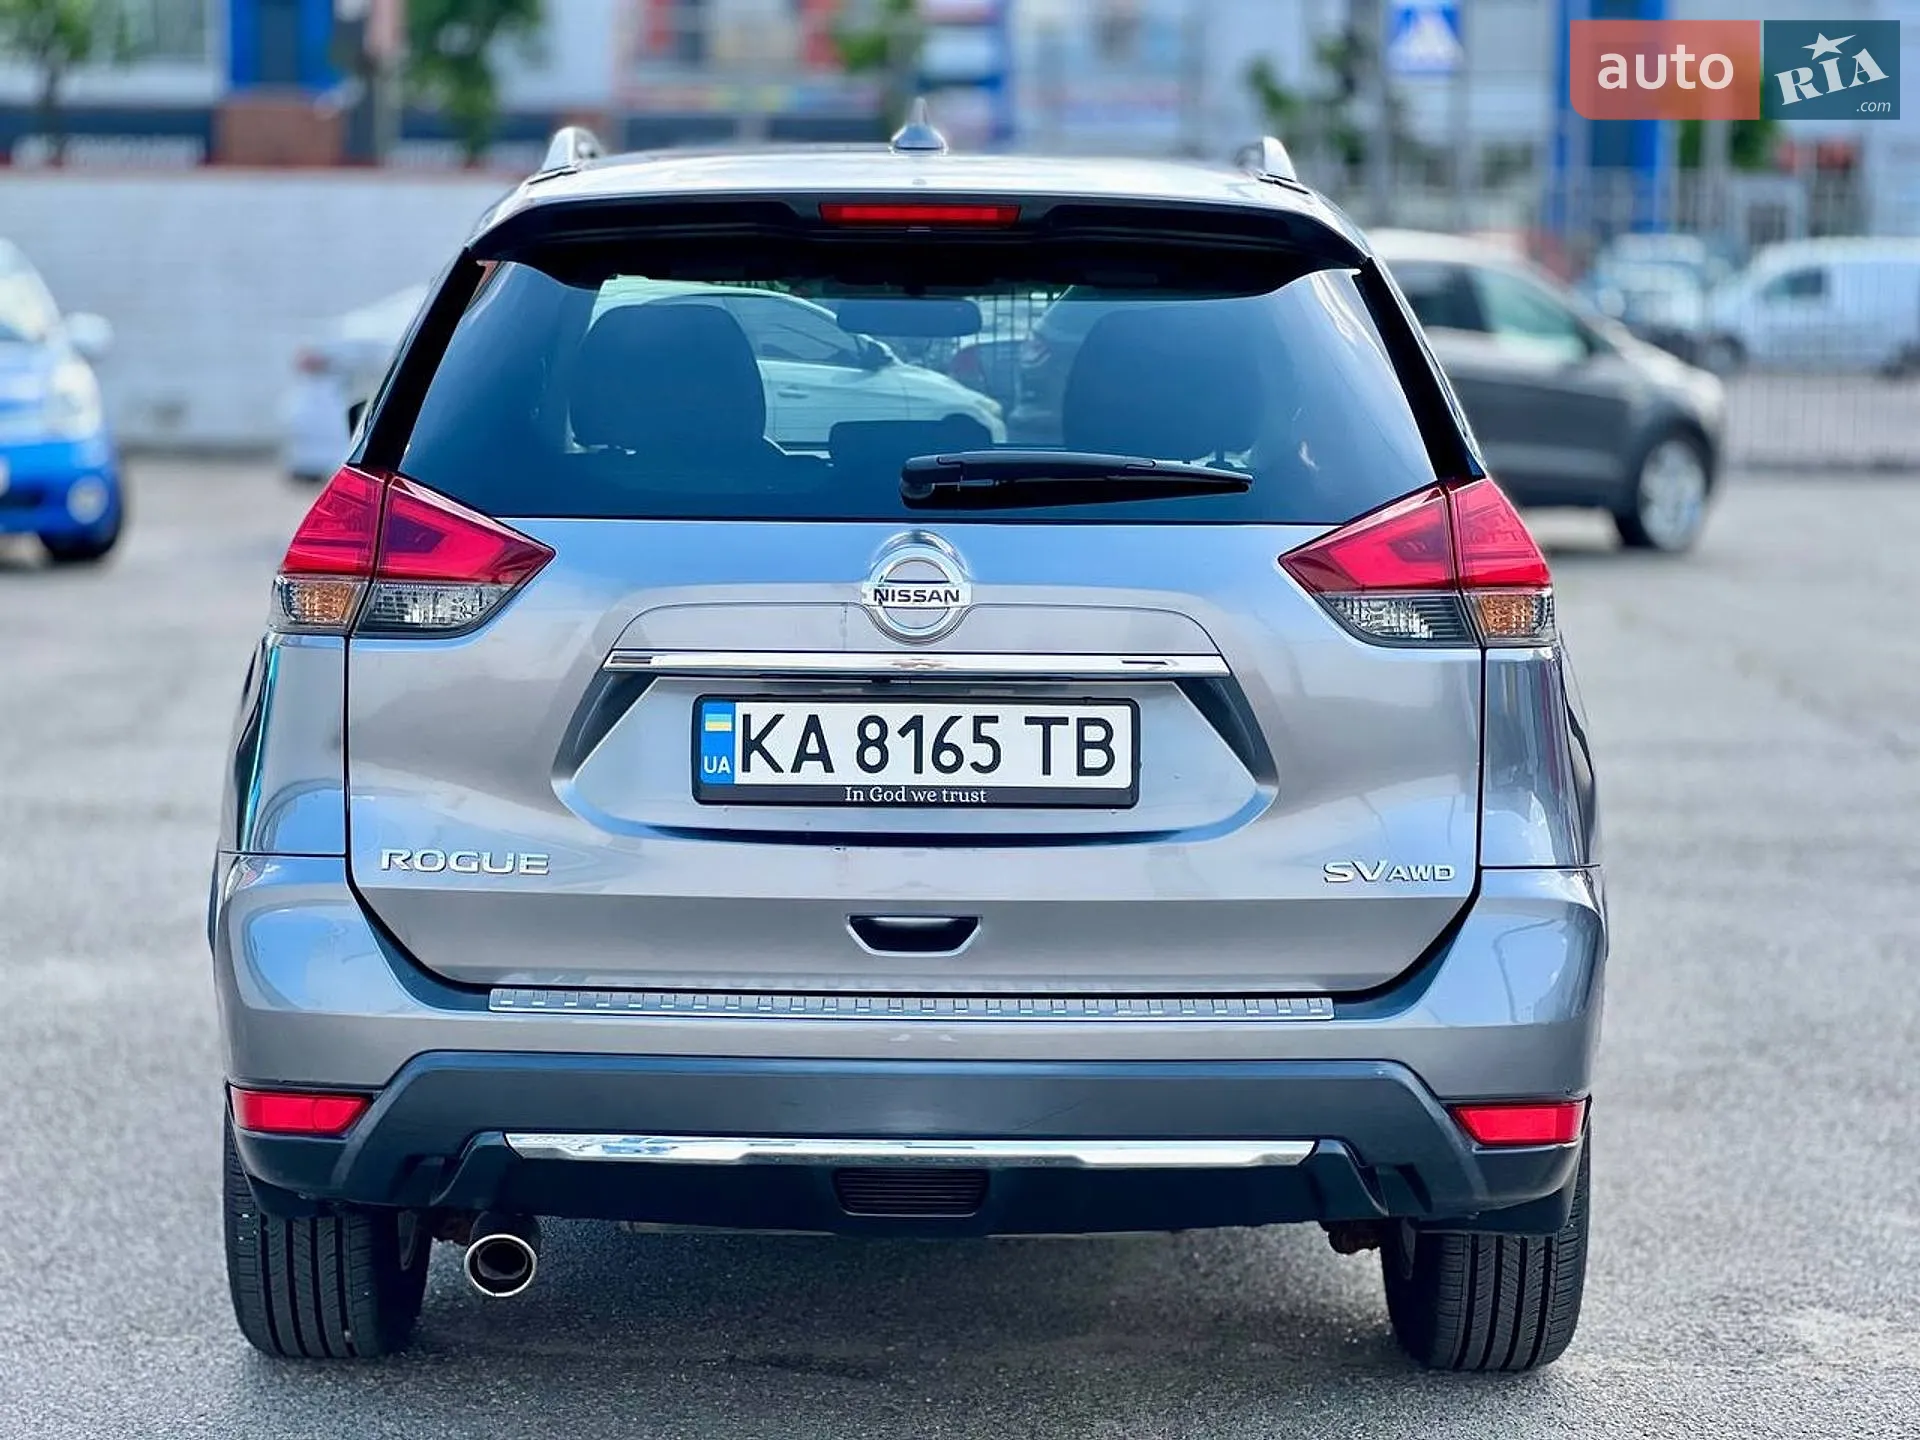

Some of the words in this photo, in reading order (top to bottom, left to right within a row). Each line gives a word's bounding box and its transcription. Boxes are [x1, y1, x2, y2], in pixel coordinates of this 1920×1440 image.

[872, 588, 960, 603] NISSAN
[740, 713, 835, 774] KA
[855, 714, 1001, 775] 8165
[1024, 715, 1117, 777] TB
[703, 755, 731, 774] UA
[844, 786, 864, 801] In
[869, 786, 907, 802] God
[910, 789, 938, 802] we
[941, 788, 987, 803] trust
[379, 848, 551, 875] ROGUE
